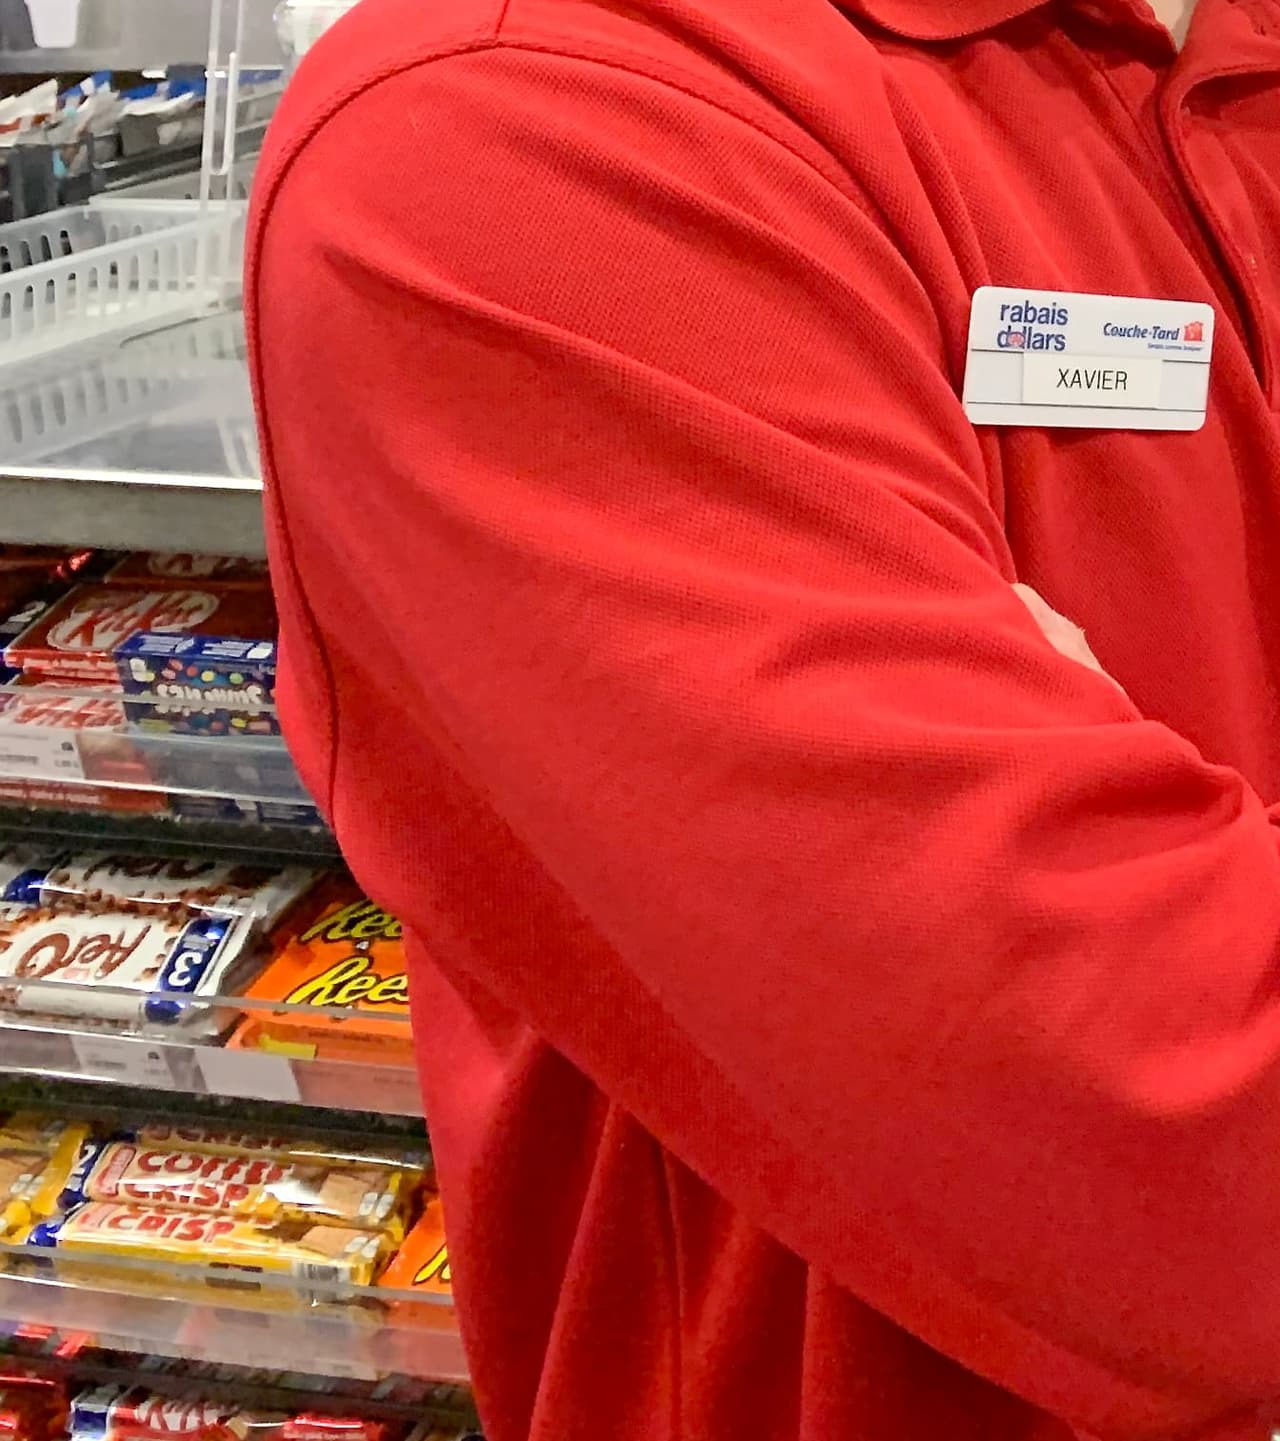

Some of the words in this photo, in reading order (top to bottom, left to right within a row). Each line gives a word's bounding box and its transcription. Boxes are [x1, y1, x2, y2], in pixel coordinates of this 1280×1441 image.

[1000, 299, 1068, 327] rabais
[1103, 322, 1180, 341] Couche-Tard
[1056, 368, 1129, 391] XAVIER
[15, 922, 152, 981] Aero
[109, 1213, 235, 1244] CRISP
